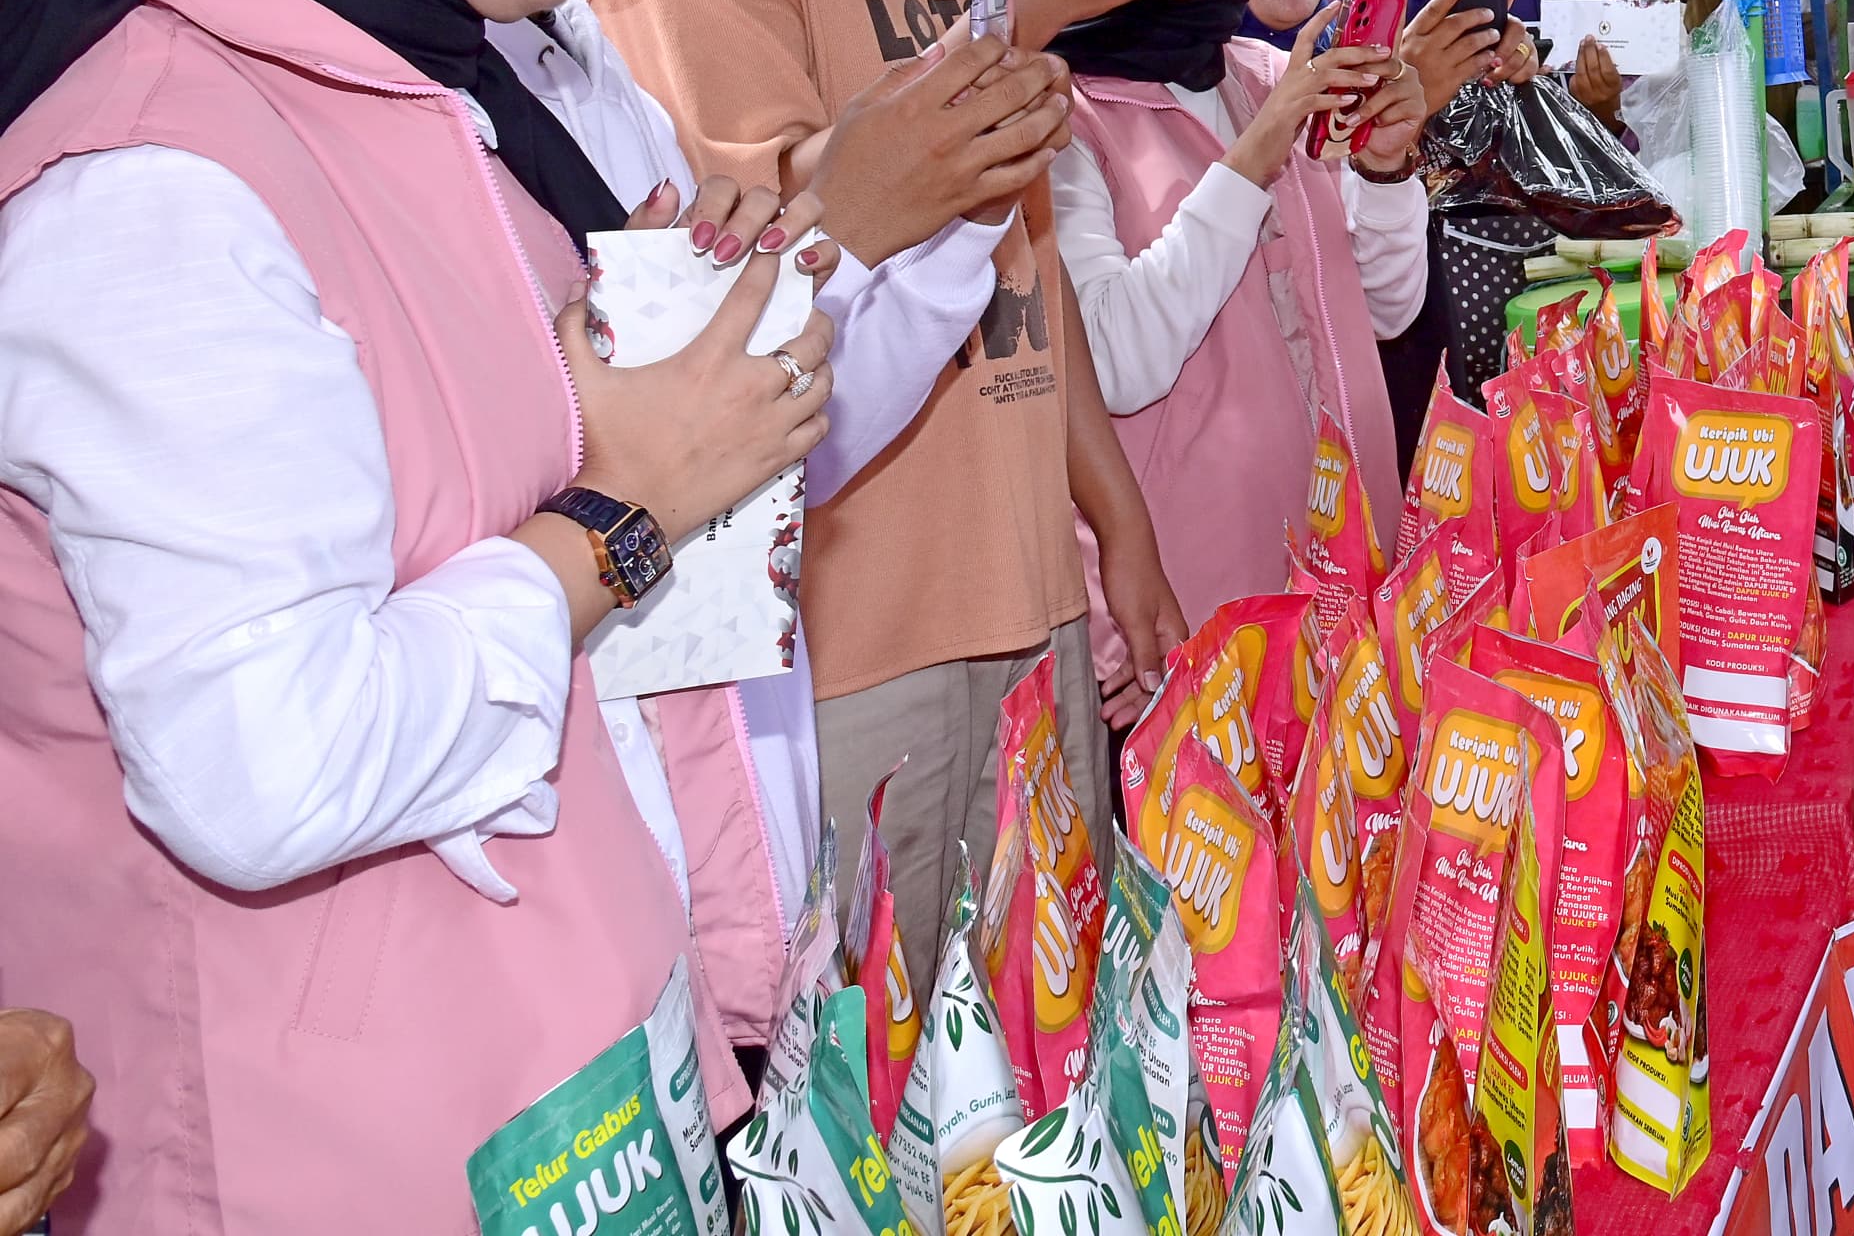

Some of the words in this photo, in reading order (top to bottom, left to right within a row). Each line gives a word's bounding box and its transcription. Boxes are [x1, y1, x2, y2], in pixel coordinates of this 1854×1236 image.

[1700, 426, 1748, 444] Keripik
[1753, 429, 1775, 442] Ubi
[1684, 444, 1776, 485] UJUK
[1423, 454, 1464, 502] UJUK
[1718, 506, 1735, 518] Oleh
[1740, 510, 1759, 524] Oleh
[1698, 514, 1720, 528] Musi
[1721, 520, 1746, 535] Rawas
[1748, 525, 1782, 540] Utara
[1778, 558, 1800, 567] Pilihan
[1615, 575, 1642, 612] DAGING
[1736, 587, 1760, 596] DAPUR
[1744, 580, 1768, 589] DAPUR
[1770, 583, 1788, 592] UJUK
[1733, 593, 1758, 602] Selatan
[1729, 616, 1748, 626] Gula,
[1750, 618, 1769, 626] Daun
[1737, 609, 1767, 620] Bawang
[1768, 612, 1788, 623] Putih,
[1699, 635, 1719, 647] Utara,
[1721, 640, 1760, 651] Sumatera
[1702, 627, 1721, 637] OLEH
[1727, 632, 1757, 642] DAPUR
[1759, 634, 1781, 644] UJUK
[1706, 659, 1725, 667] KODE
[1726, 661, 1765, 672] PRODUKSI
[1213, 666, 1246, 721] Keripik
[1345, 661, 1381, 717] Keripik
[1559, 699, 1581, 720] Ubi
[1700, 706, 1747, 717] DIGUNAKAN
[1449, 729, 1500, 761] Keripik
[1184, 807, 1224, 848] Keripik
[1224, 829, 1242, 860] Ubi
[1164, 832, 1234, 928] UJUK
[1560, 872, 1581, 882] Baku
[1583, 876, 1612, 888] Pilihan
[1560, 891, 1591, 901] Sangat
[1566, 884, 1601, 895] Renyah,
[1558, 899, 1603, 912] Penasaran
[1464, 907, 1486, 921] Rawas
[1571, 910, 1597, 920] UJUK
[1598, 913, 1609, 921] EF
[1467, 919, 1492, 932] Bahan
[1561, 917, 1585, 927] UJUK
[1587, 920, 1598, 928] EF
[1102, 904, 1144, 982] JUK
[1452, 934, 1481, 947] Cemilan
[1570, 944, 1596, 955] Putih,
[1559, 971, 1588, 982] UJUK
[1202, 1026, 1226, 1034] Baku
[1229, 1026, 1256, 1042] Pilihan
[1211, 1034, 1246, 1049] Renyah,
[1206, 1043, 1238, 1056] Sangat
[1203, 1052, 1248, 1068] Penasaran
[1218, 1066, 1242, 1077] UJUK
[1639, 1059, 1666, 1082] PRODUKSI
[1206, 1074, 1232, 1085] UJUK
[1234, 1078, 1244, 1088] EF
[969, 1089, 1005, 1114] Gurih,
[1215, 1108, 1242, 1123] Putih,
[1643, 1121, 1666, 1143] SEBELUM
[509, 1151, 570, 1207] Telur
[574, 1094, 642, 1159] Gabus
[850, 1134, 891, 1208] Tel
[921, 1171, 930, 1185] EF
[924, 1190, 934, 1204] EF
